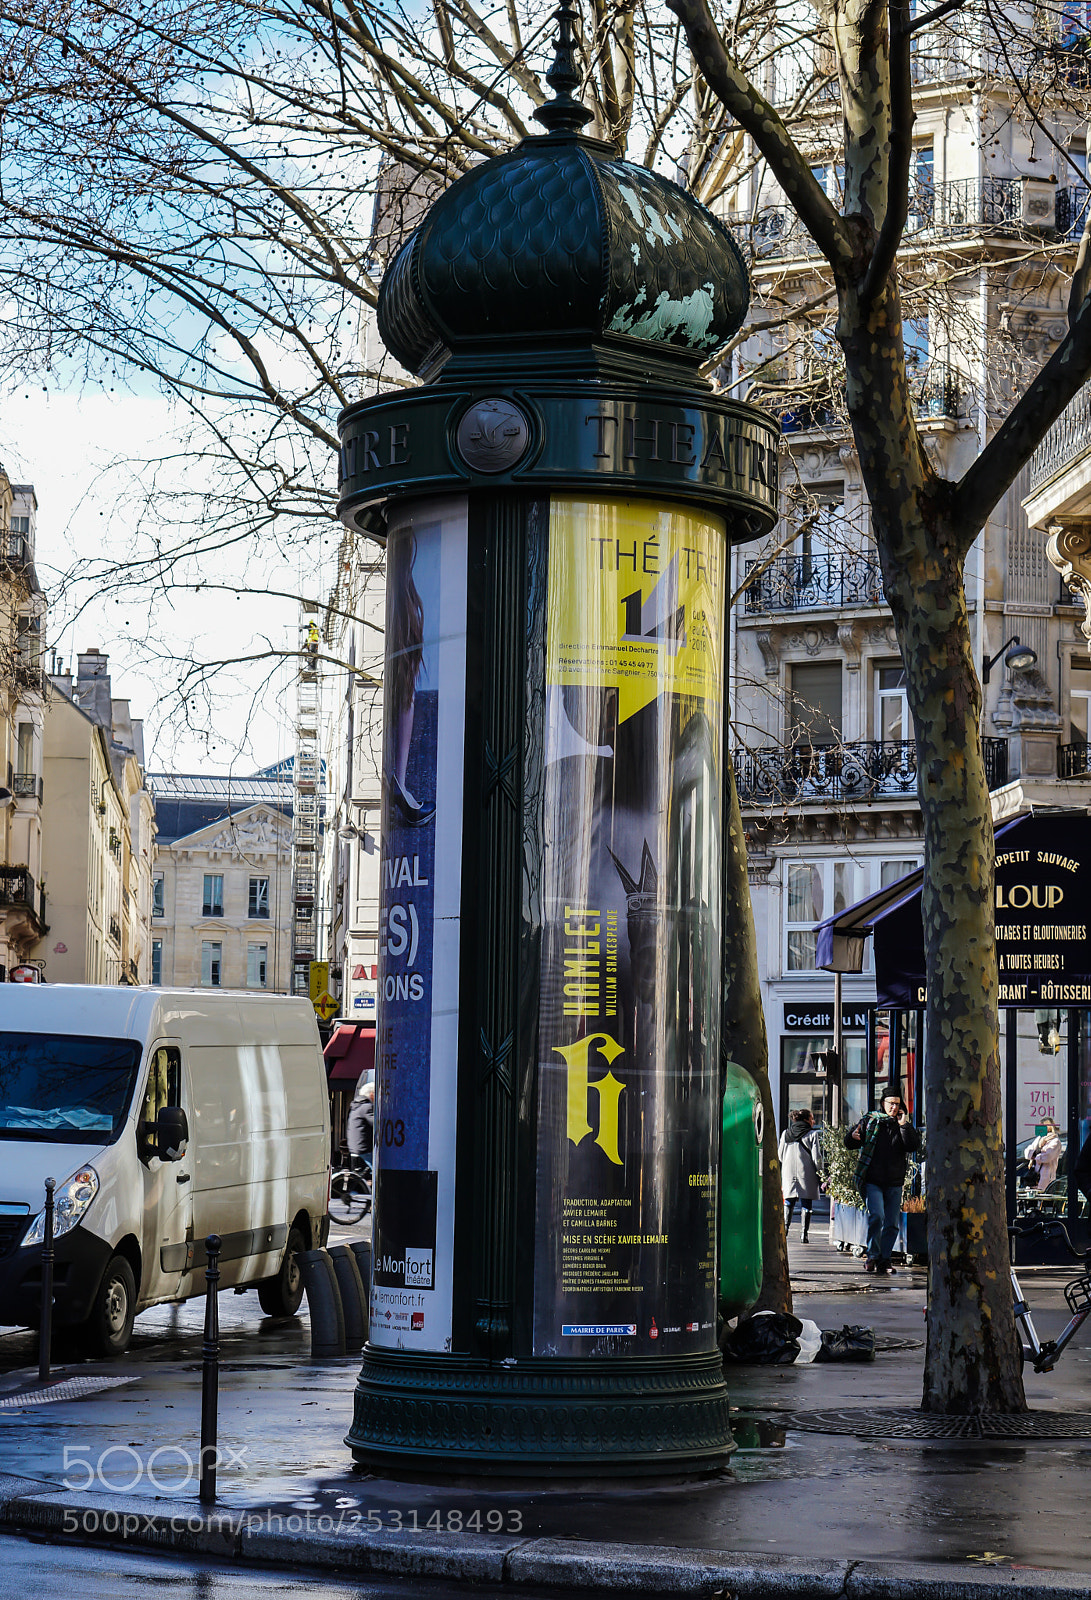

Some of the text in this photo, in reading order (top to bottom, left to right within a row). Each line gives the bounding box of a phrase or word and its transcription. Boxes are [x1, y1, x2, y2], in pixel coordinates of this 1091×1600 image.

[585, 415, 778, 491] THEATRE
[592, 643, 628, 653] Emmanuel
[628, 660, 636, 668] 45
[1036, 851, 1081, 873] SAUVAGE
[996, 884, 1064, 909] LOUP
[1022, 925, 1032, 940] ET
[1033, 924, 1087, 941] GLOUTONNERIES
[563, 905, 601, 1016] HAMLET
[606, 908, 618, 1017] WILLIAM SHAKESPEARE
[1006, 954, 1032, 970] TOUTES
[1033, 954, 1060, 970] HEURES
[786, 1014, 830, 1026] Crédit
[1030, 1105, 1055, 1118] 20H
[562, 1198, 632, 1208] TRADUCTION, ADAPTATION
[562, 1209, 607, 1217] XAVIER LEMAIRE
[596, 1220, 618, 1228] BARNES
[562, 1233, 669, 1244] MISE EN SCÈNE XAVIER LEMAIRE
[382, 1254, 431, 1275] Monfort
[406, 1274, 430, 1285] théâtre
